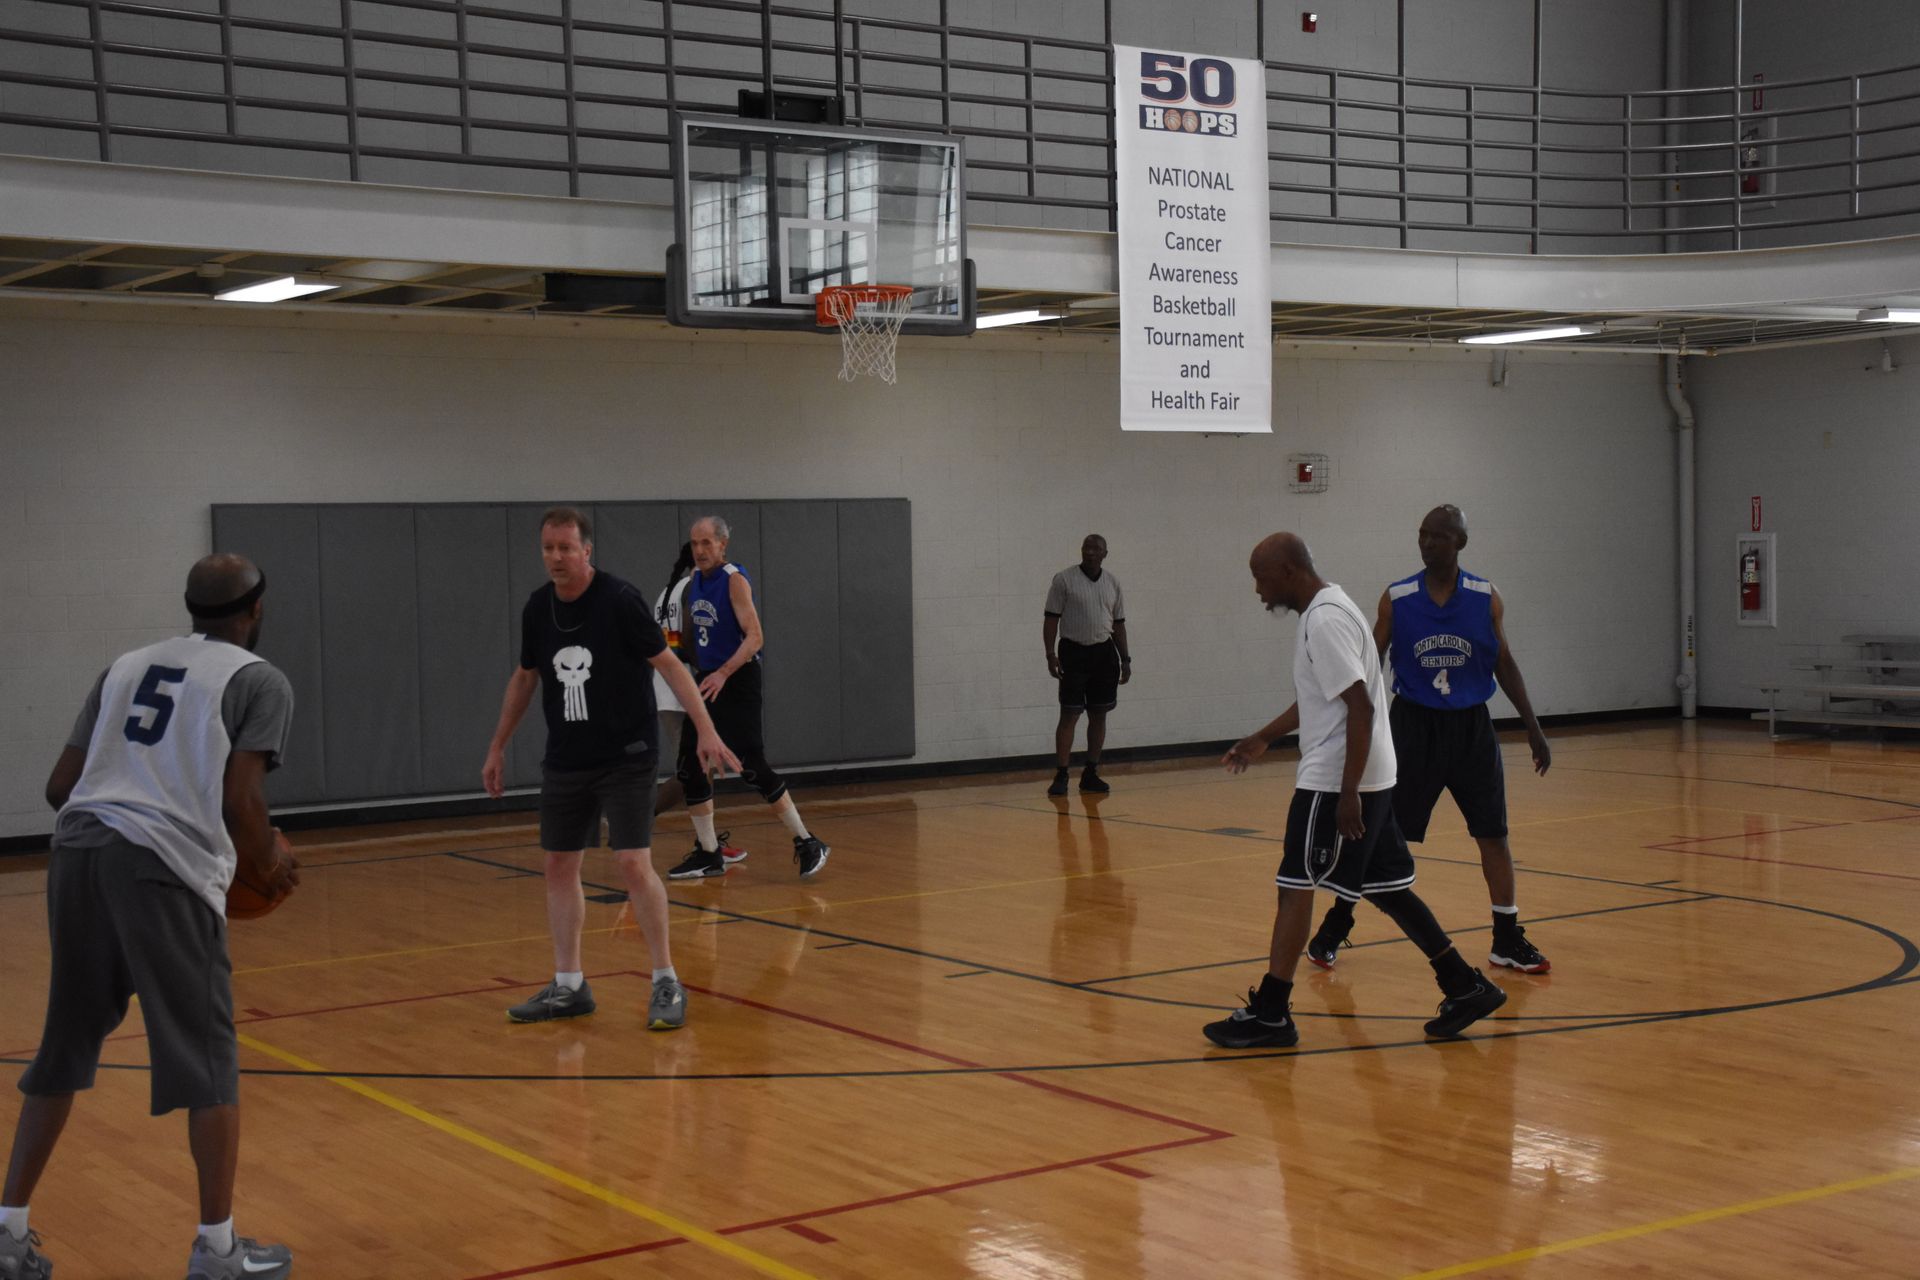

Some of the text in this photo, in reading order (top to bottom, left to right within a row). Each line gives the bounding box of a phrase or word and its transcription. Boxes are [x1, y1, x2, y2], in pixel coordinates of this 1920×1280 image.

[1141, 52, 1236, 108] 50
[1144, 107, 1236, 135] HOOPS
[1148, 166, 1234, 191] NATIONAL
[1158, 199, 1226, 222] Prostate
[1165, 231, 1222, 252] Cancer
[1148, 262, 1238, 285] Awareness
[1153, 294, 1236, 317] Basketball
[1143, 326, 1245, 349] Tournament
[1180, 359, 1210, 379] and
[1151, 390, 1240, 411] Health Fair
[699, 626, 709, 647] 3
[1421, 655, 1465, 667] SENIORS
[1432, 668, 1451, 695] 4
[123, 664, 188, 746] 5
